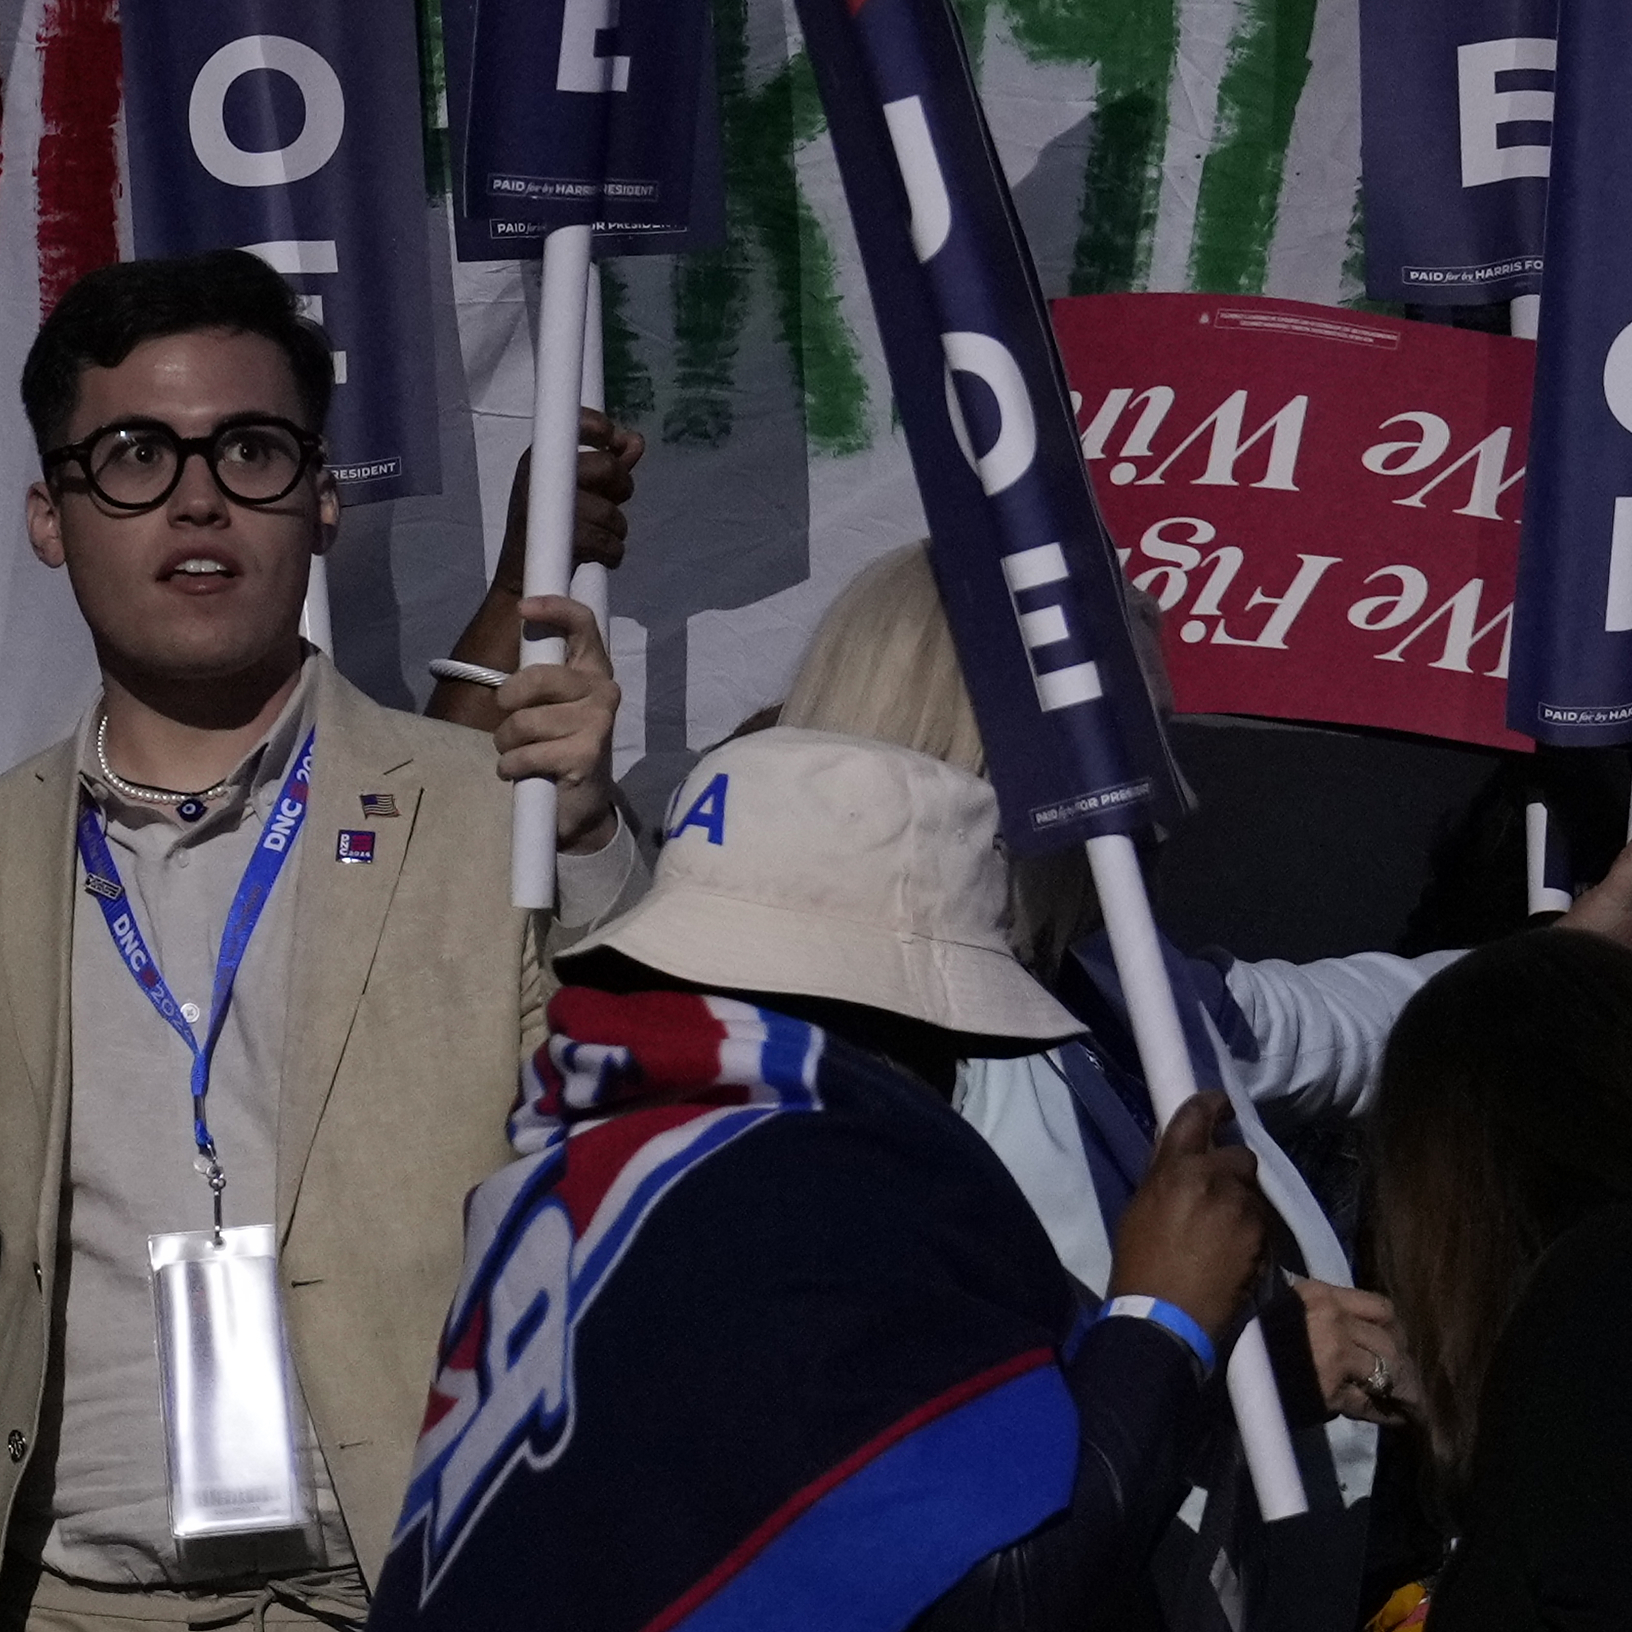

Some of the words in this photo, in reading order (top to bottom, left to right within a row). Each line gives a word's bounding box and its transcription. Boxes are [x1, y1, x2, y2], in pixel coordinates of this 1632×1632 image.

[492, 179, 525, 193] PAID
[497, 222, 525, 234] PAID
[1410, 270, 1443, 282] PAID
[1475, 260, 1522, 281] HARRIS
[1524, 259, 1545, 271] FO
[332, 461, 396, 480] RESIDENT
[1361, 410, 1527, 524] We
[1115, 516, 1344, 651] Fig
[1347, 563, 1515, 680] We
[1544, 707, 1578, 721] PAID
[262, 796, 303, 854] DNC
[112, 912, 147, 973] DNC
